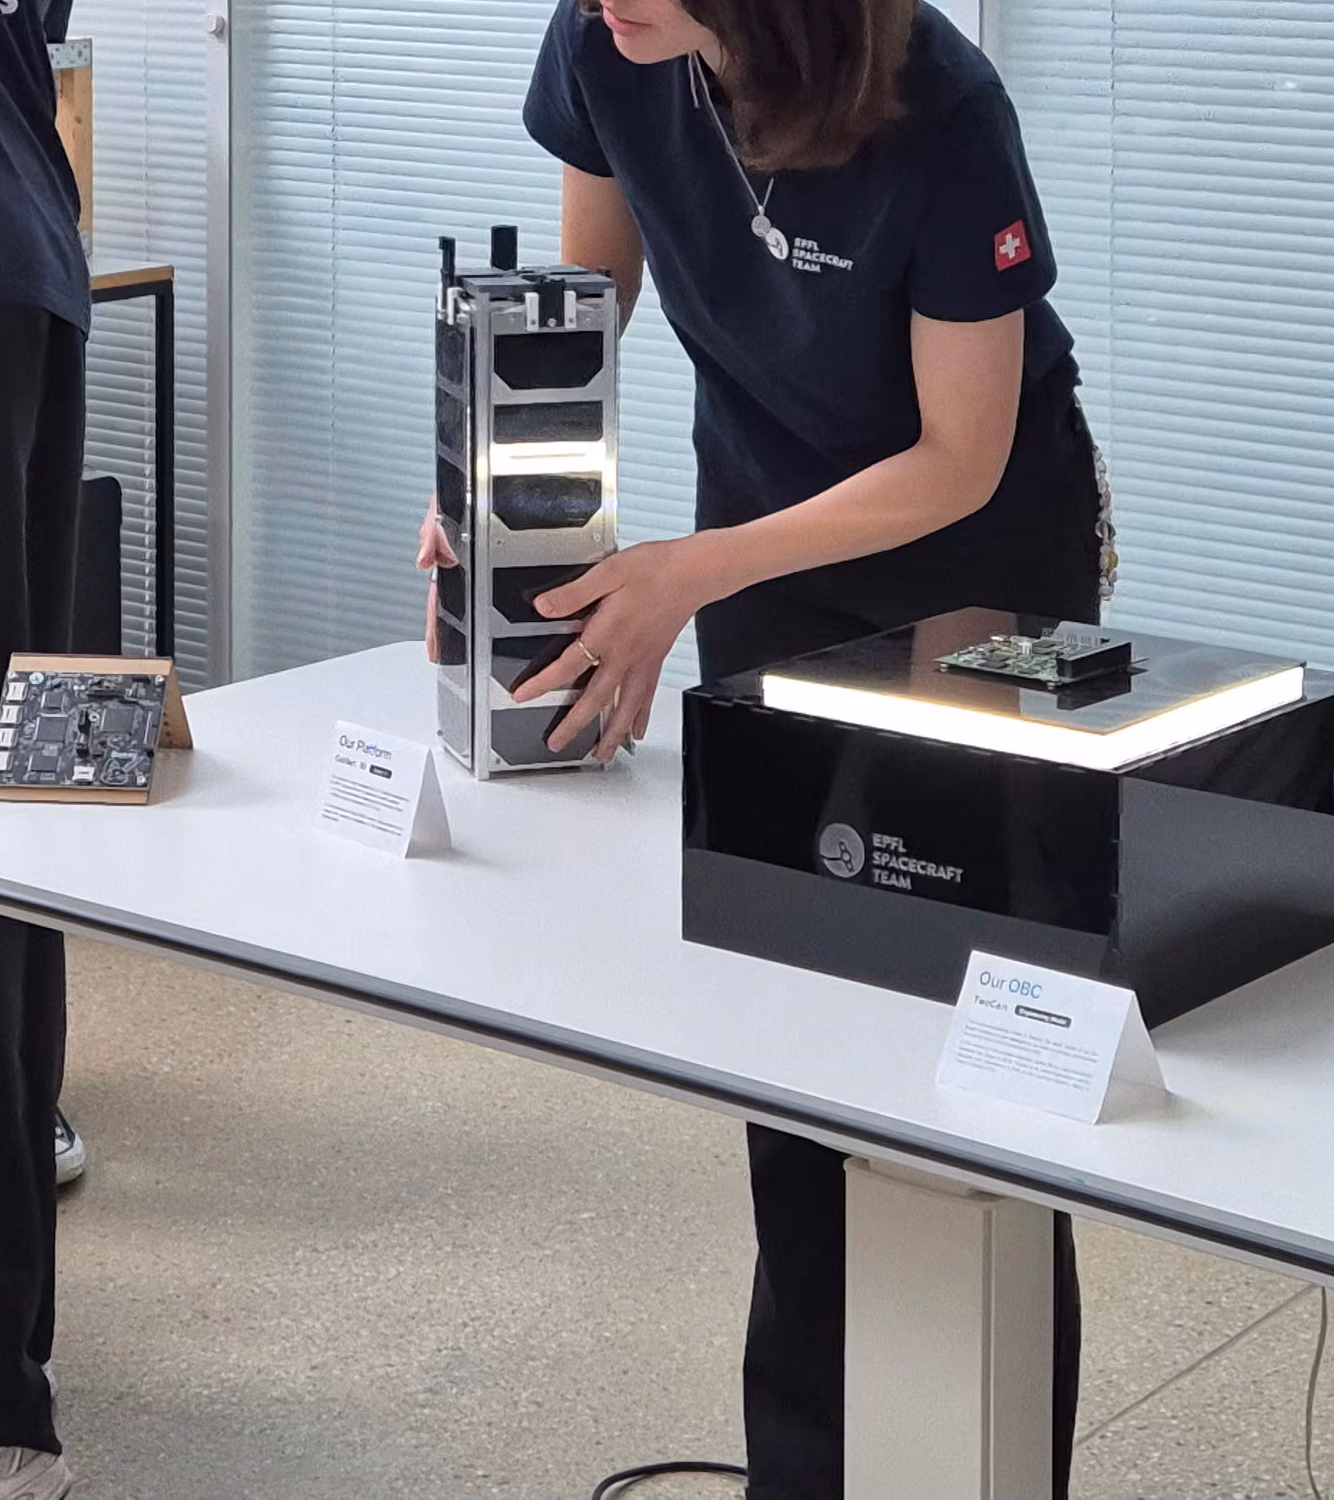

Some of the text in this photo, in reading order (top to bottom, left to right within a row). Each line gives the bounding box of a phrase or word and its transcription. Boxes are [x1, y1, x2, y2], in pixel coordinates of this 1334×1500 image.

[794, 237, 819, 251] EPFL
[792, 248, 854, 270] SPACECRAFT
[792, 258, 821, 272] TEAM
[872, 832, 907, 853] EPFL
[872, 851, 964, 884] SPACECRAFT
[872, 868, 913, 890] TEAM
[979, 970, 1043, 999] Our OBC
